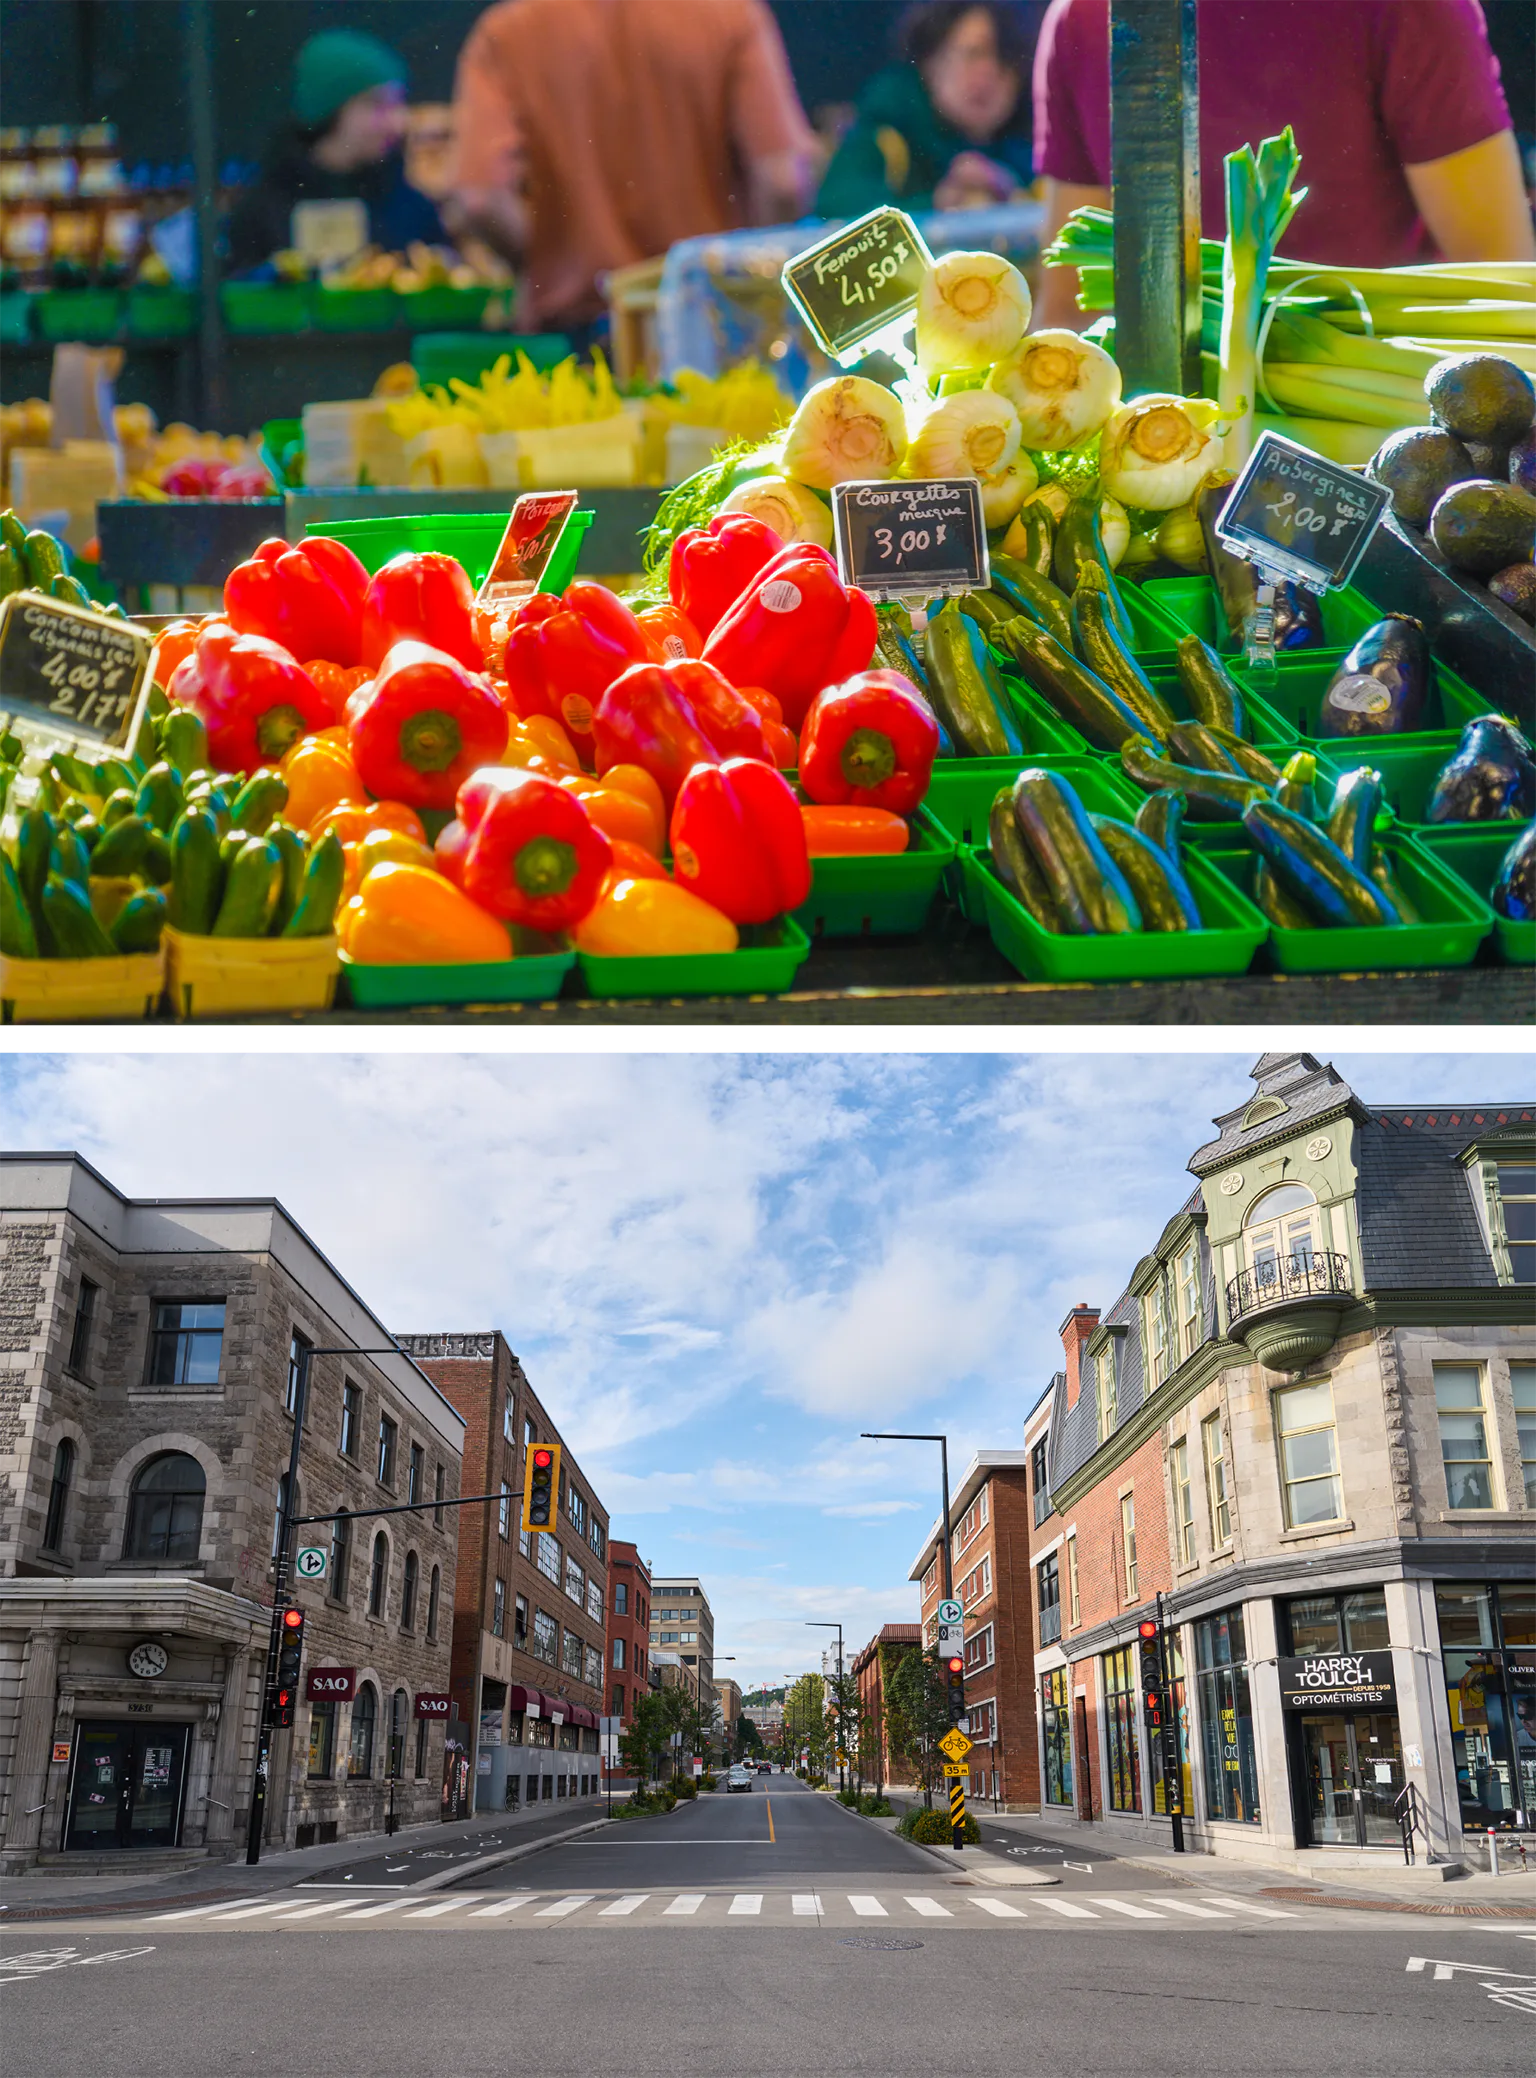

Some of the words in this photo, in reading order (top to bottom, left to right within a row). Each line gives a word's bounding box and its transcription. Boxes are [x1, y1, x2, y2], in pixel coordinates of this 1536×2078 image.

[1263, 451, 1367, 509] Aubergines
[856, 483, 961, 511] Courgettes
[1304, 1656, 1364, 1672] HARRY
[312, 1677, 349, 1691] SAQ
[1295, 1668, 1373, 1687] TOULCH
[1292, 1691, 1383, 1705] OPTOMÉTRISTES
[420, 1700, 448, 1712] SAQ
[946, 1766, 959, 1775] 35
